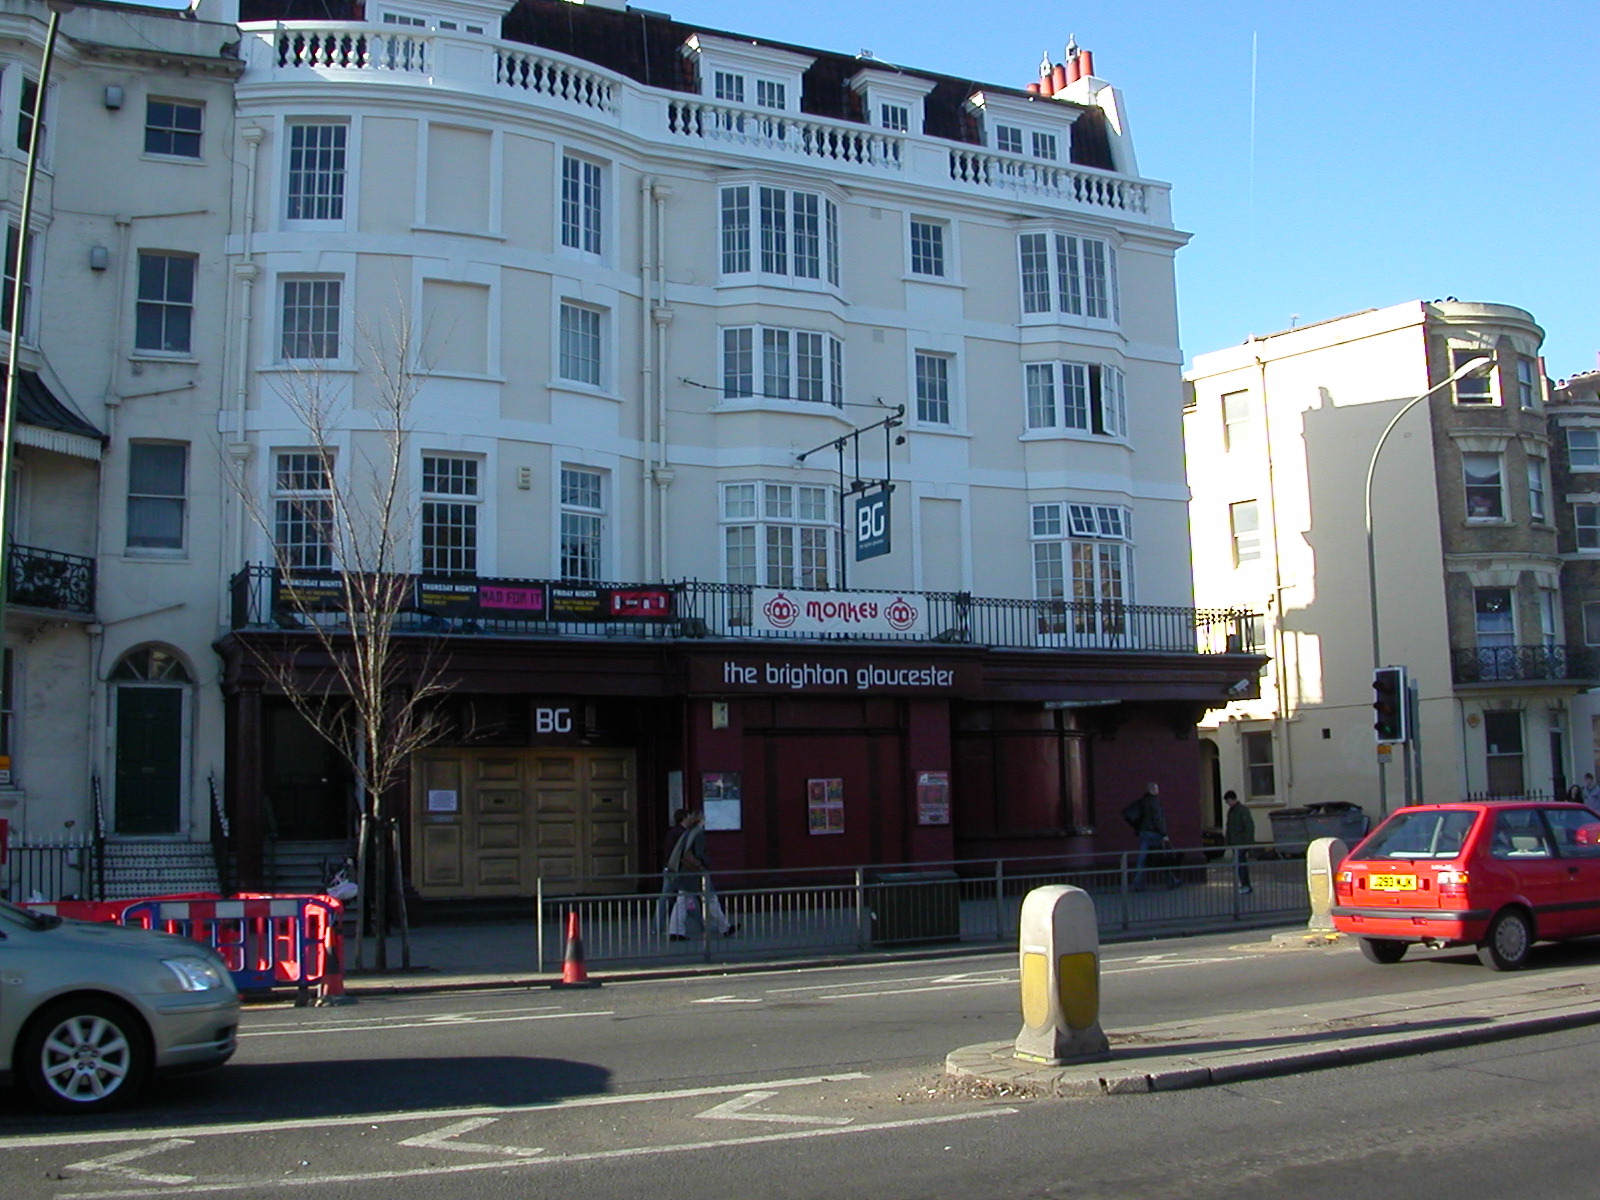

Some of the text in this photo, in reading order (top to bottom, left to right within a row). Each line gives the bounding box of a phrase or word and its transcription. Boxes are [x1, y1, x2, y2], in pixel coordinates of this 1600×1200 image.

[858, 501, 885, 542] BG
[422, 583, 477, 593] THURSDAY NIGHTS
[481, 591, 504, 603] MAD
[506, 592, 527, 604] FOR
[530, 593, 542, 605] IT
[553, 589, 597, 598] FRIDAY NIGHTS
[724, 661, 954, 690] the brighton gloucester
[535, 708, 572, 734] BG
